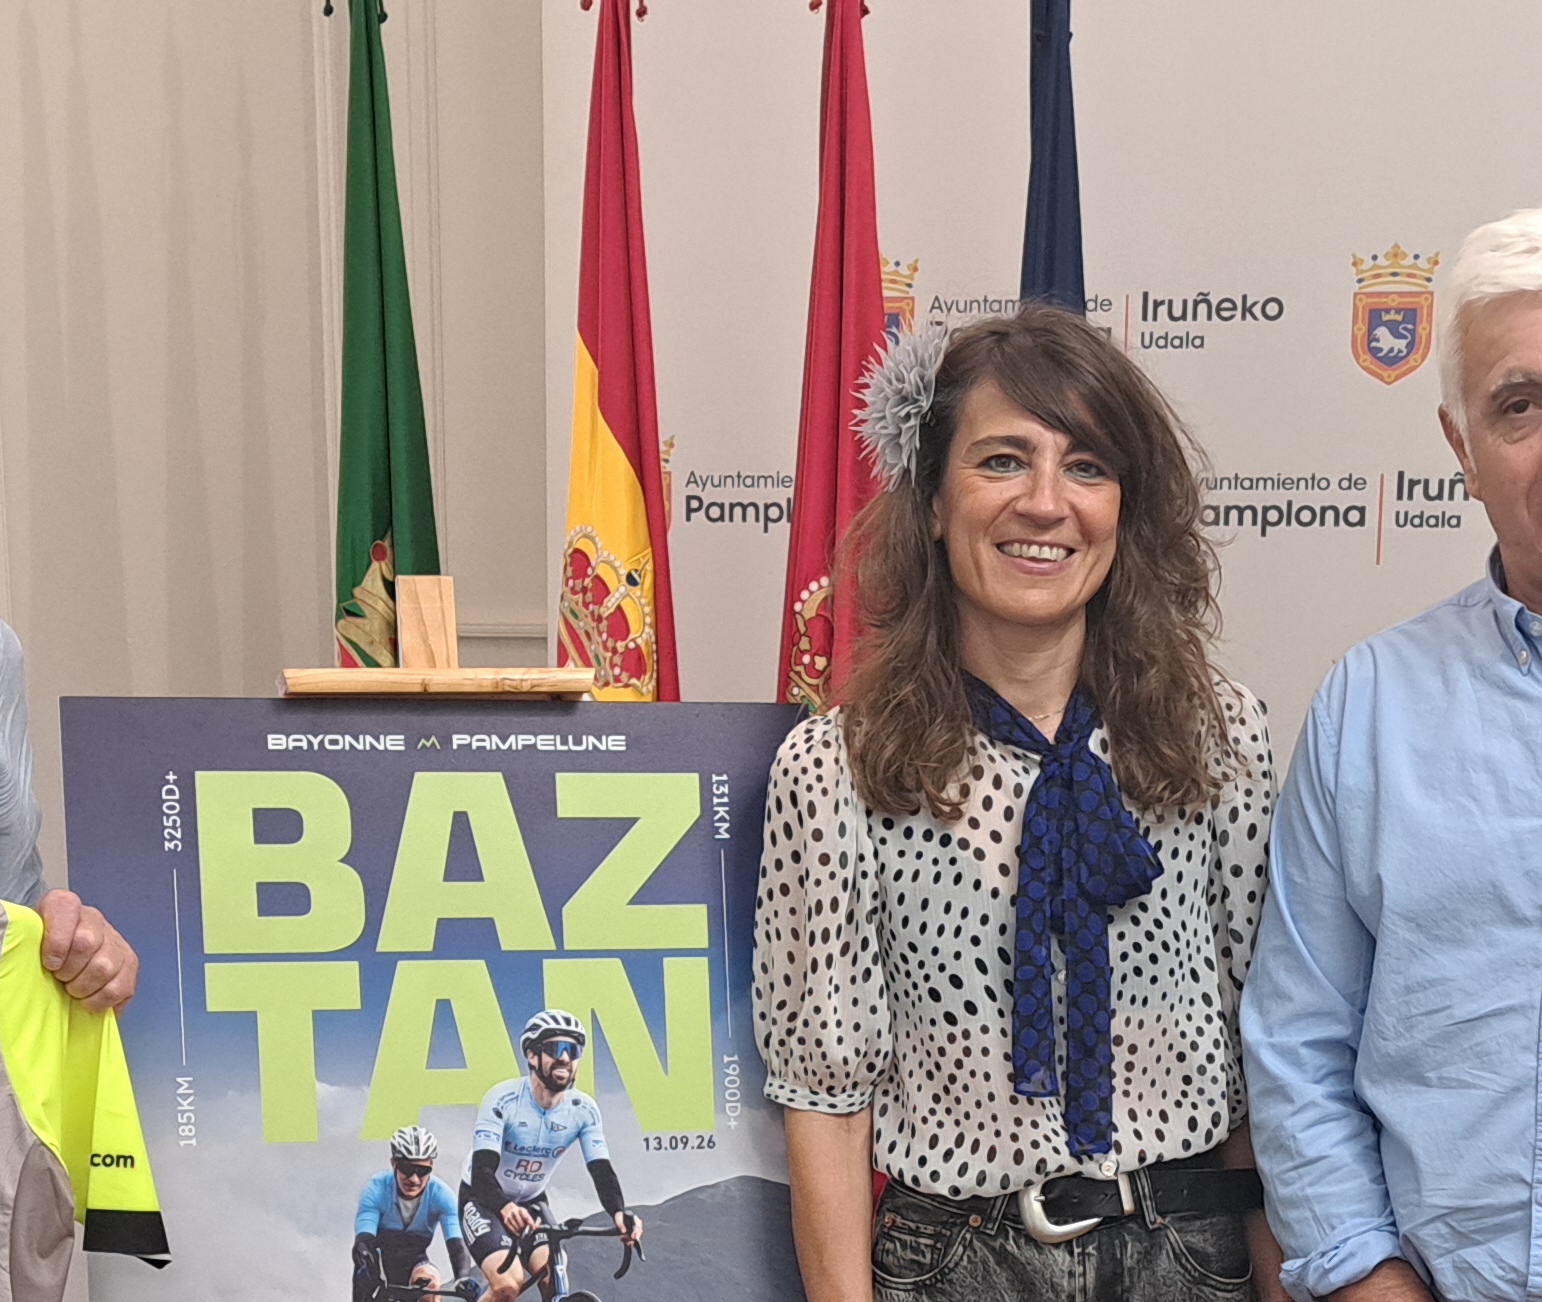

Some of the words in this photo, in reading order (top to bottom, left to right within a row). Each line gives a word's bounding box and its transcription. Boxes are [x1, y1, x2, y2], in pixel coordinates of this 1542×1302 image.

[929, 295, 1022, 314] Ayuntam
[1086, 295, 1113, 313] de
[1142, 291, 1284, 322] Iruñeko
[1141, 331, 1204, 349] Udala
[685, 471, 793, 492] Ayuntamie
[1200, 473, 1330, 491] untamiento
[1338, 473, 1367, 491] de
[1396, 471, 1469, 501] Iruñ
[685, 495, 792, 533] Pampl
[1200, 500, 1366, 537] amplona
[1395, 511, 1461, 528] Udala
[266, 734, 405, 751] BAYONNE
[452, 734, 627, 751] PAMPELUNE
[162, 770, 183, 852] 3250D+
[711, 773, 731, 839] 131KM
[195, 770, 710, 955] BAZ
[204, 956, 715, 1143] TAN
[723, 1055, 741, 1130] 1900D+
[175, 1077, 196, 1147] 185KM
[642, 1134, 716, 1152] 13.09.26
[90, 1153, 135, 1169] com
[515, 1158, 543, 1174] RD
[504, 1169, 546, 1182] CYCLES
